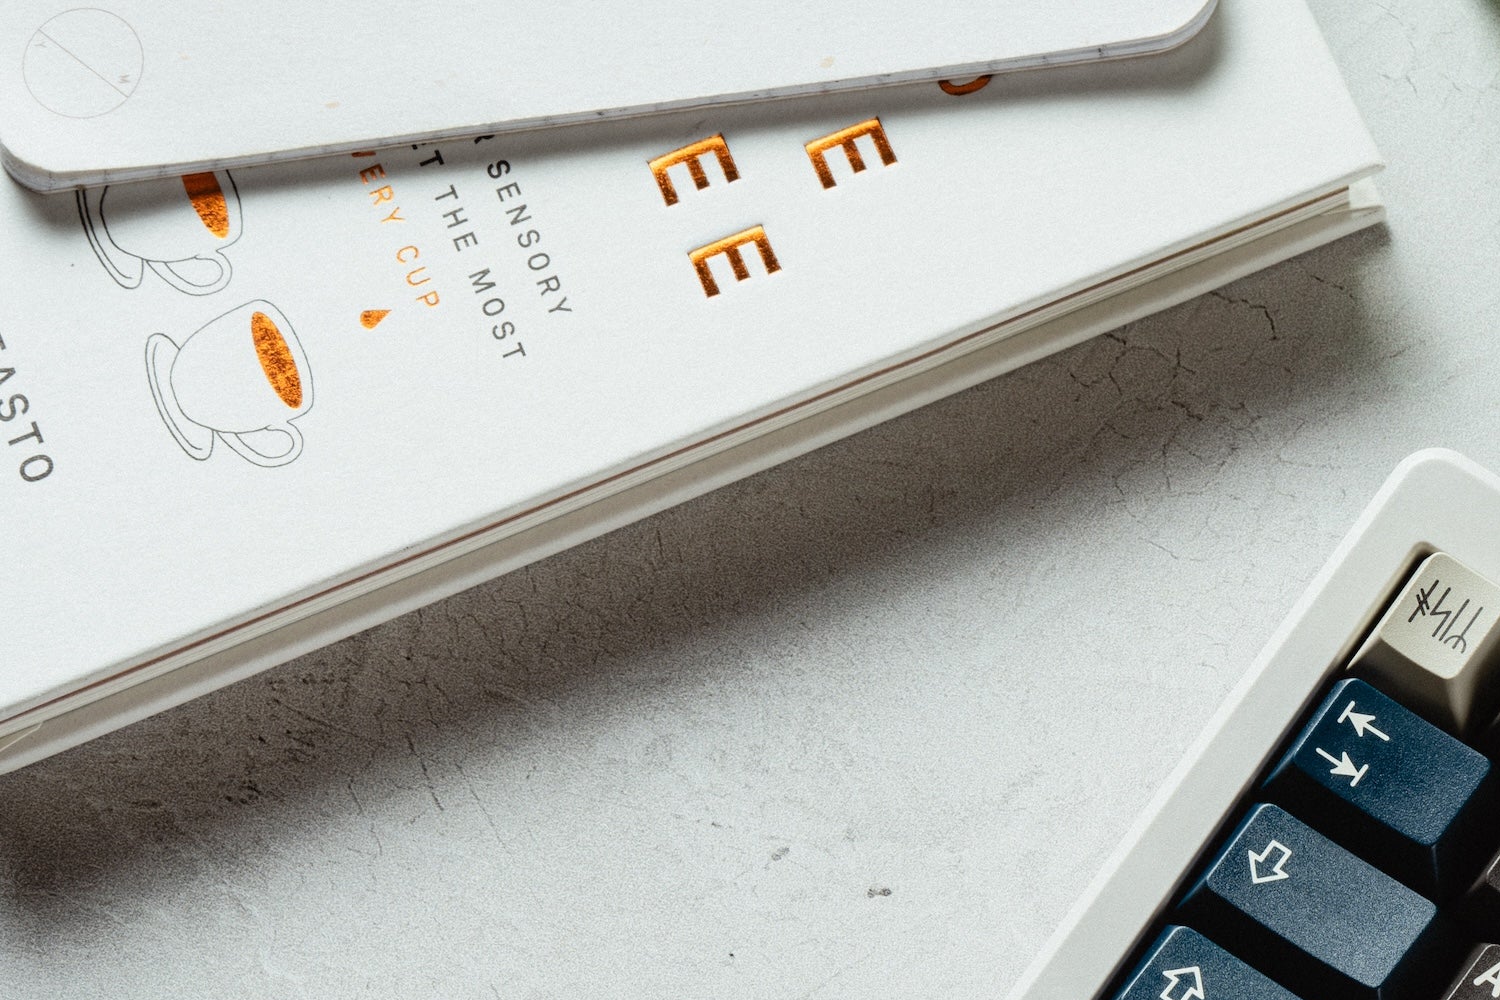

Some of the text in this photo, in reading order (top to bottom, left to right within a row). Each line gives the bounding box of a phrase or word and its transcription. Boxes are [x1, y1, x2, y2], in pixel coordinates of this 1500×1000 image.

[396, 245, 440, 308] CUP
[434, 183, 479, 252] THE
[468, 267, 527, 358] MOST
[486, 158, 573, 314] SENSORY
